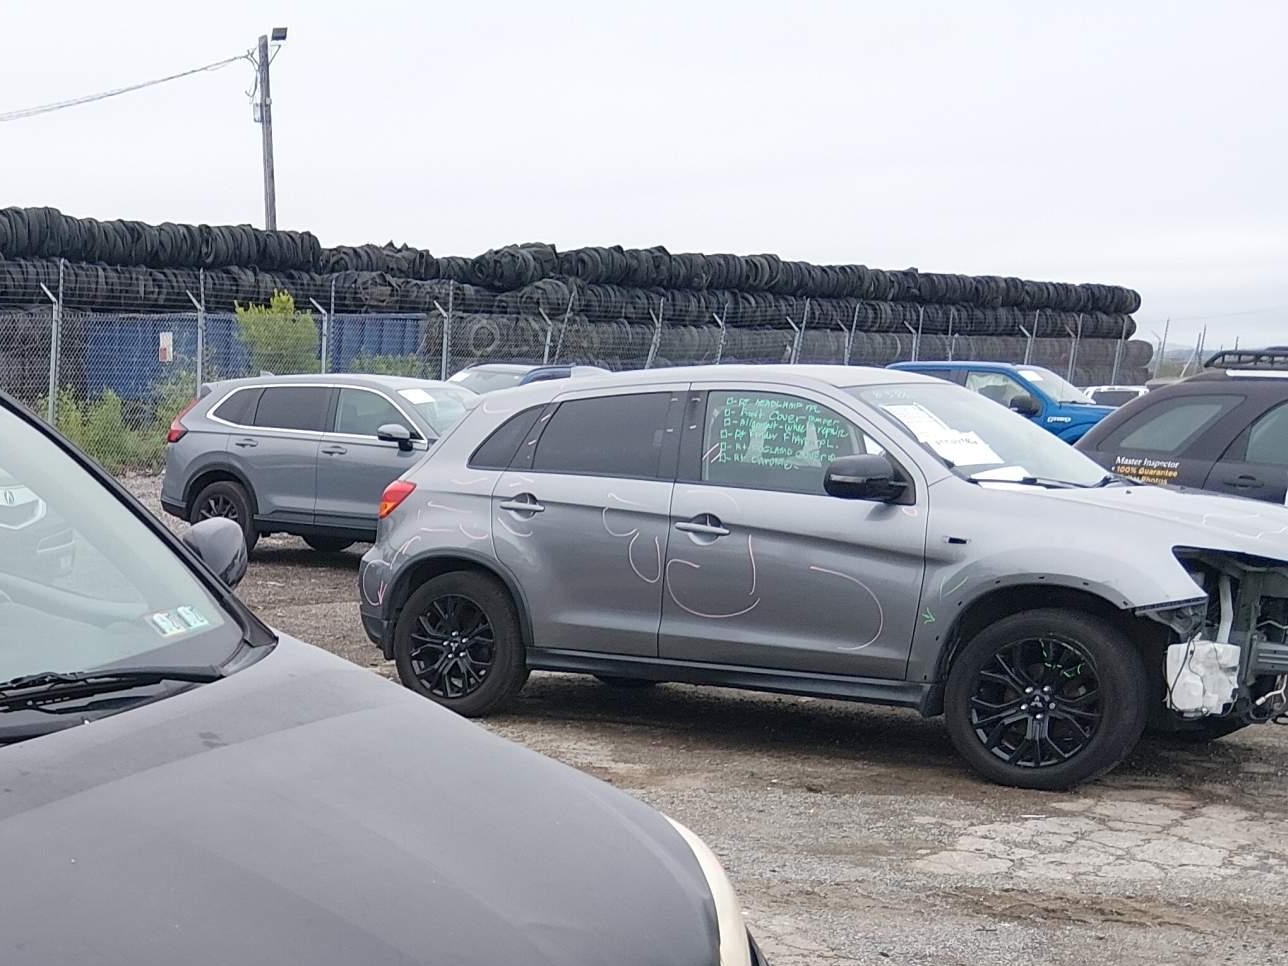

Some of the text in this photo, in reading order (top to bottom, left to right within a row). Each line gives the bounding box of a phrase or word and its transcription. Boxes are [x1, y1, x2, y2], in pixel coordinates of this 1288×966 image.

[1116, 457, 1180, 468] Master Inspector
[1117, 465, 1178, 477] 100% Guarantee
